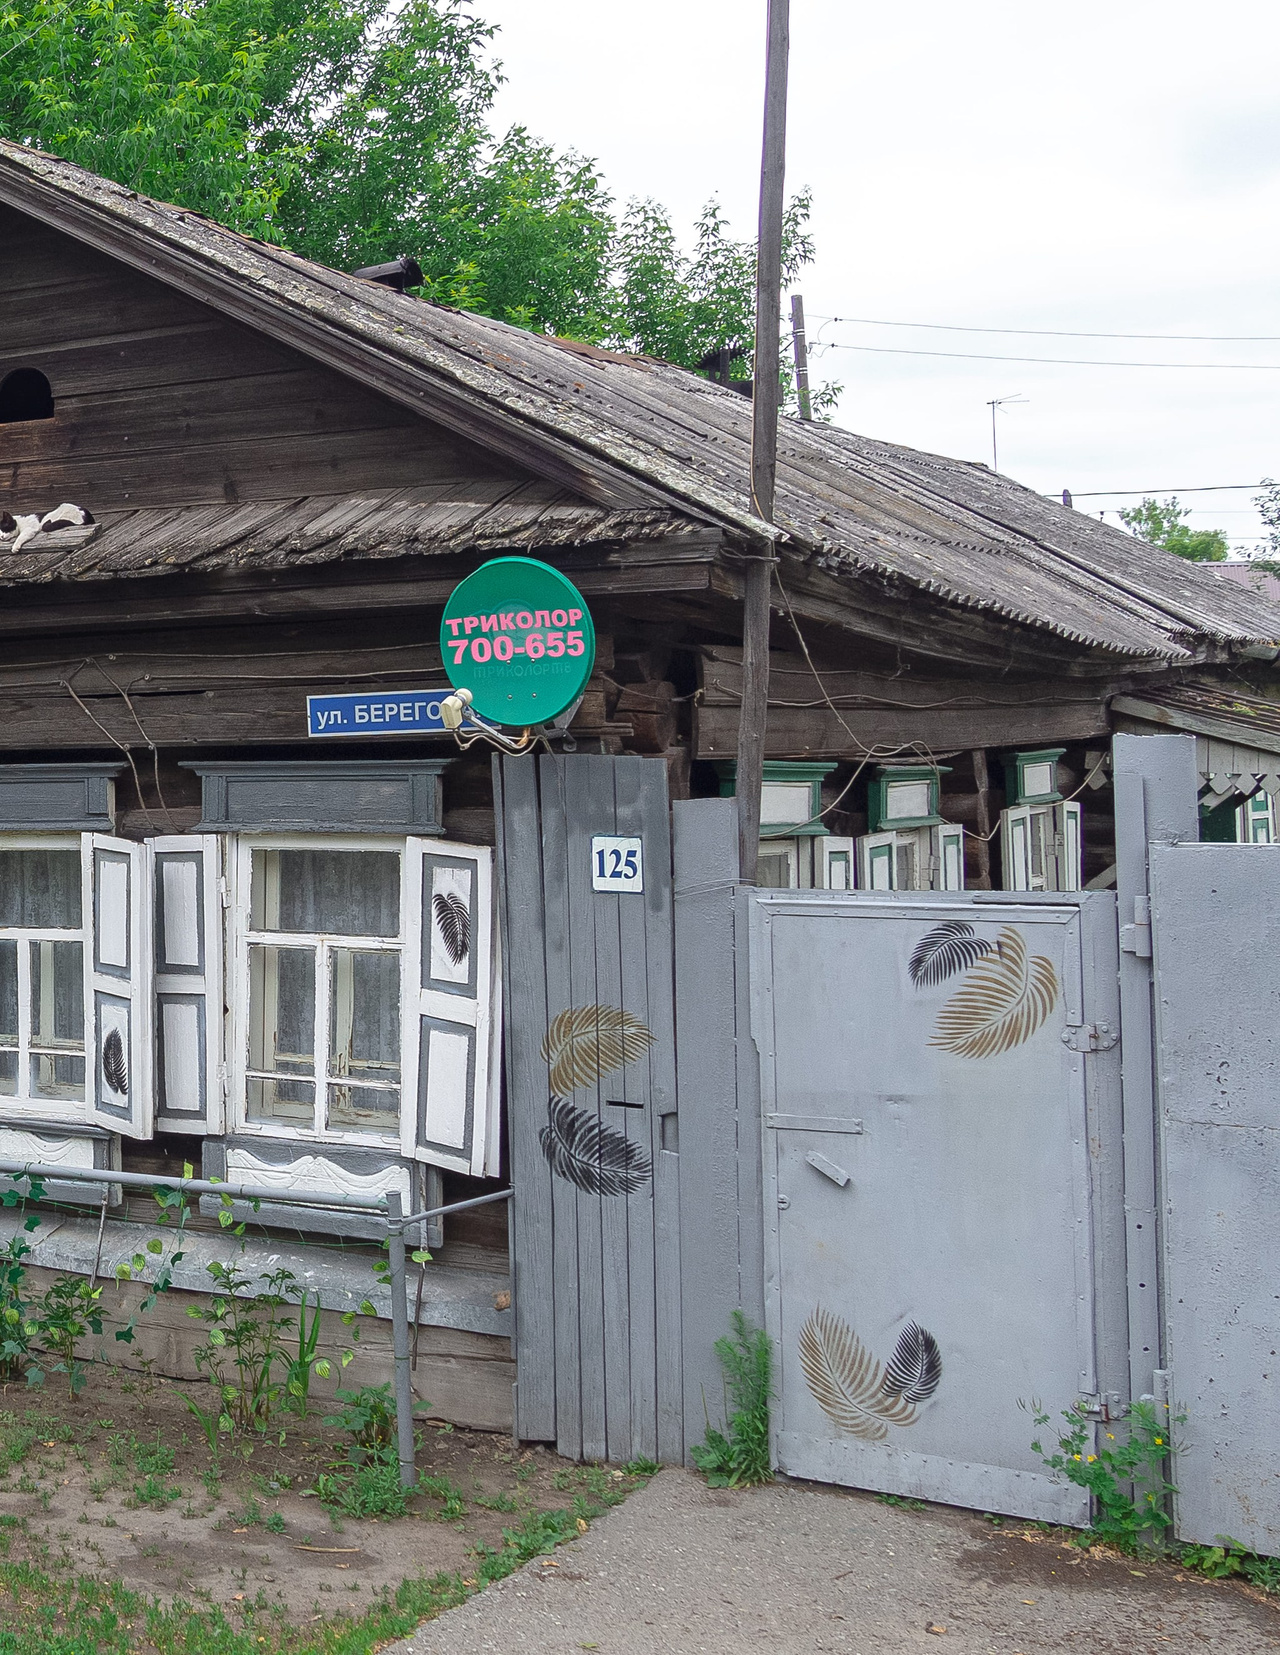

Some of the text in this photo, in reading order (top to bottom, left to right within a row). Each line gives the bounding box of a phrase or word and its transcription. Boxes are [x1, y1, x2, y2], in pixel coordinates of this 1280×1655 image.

[445, 608, 583, 636] ТРИКОЛОР
[447, 630, 585, 665] 700-655
[317, 709, 348, 730] ул.
[596, 848, 638, 880] 125
